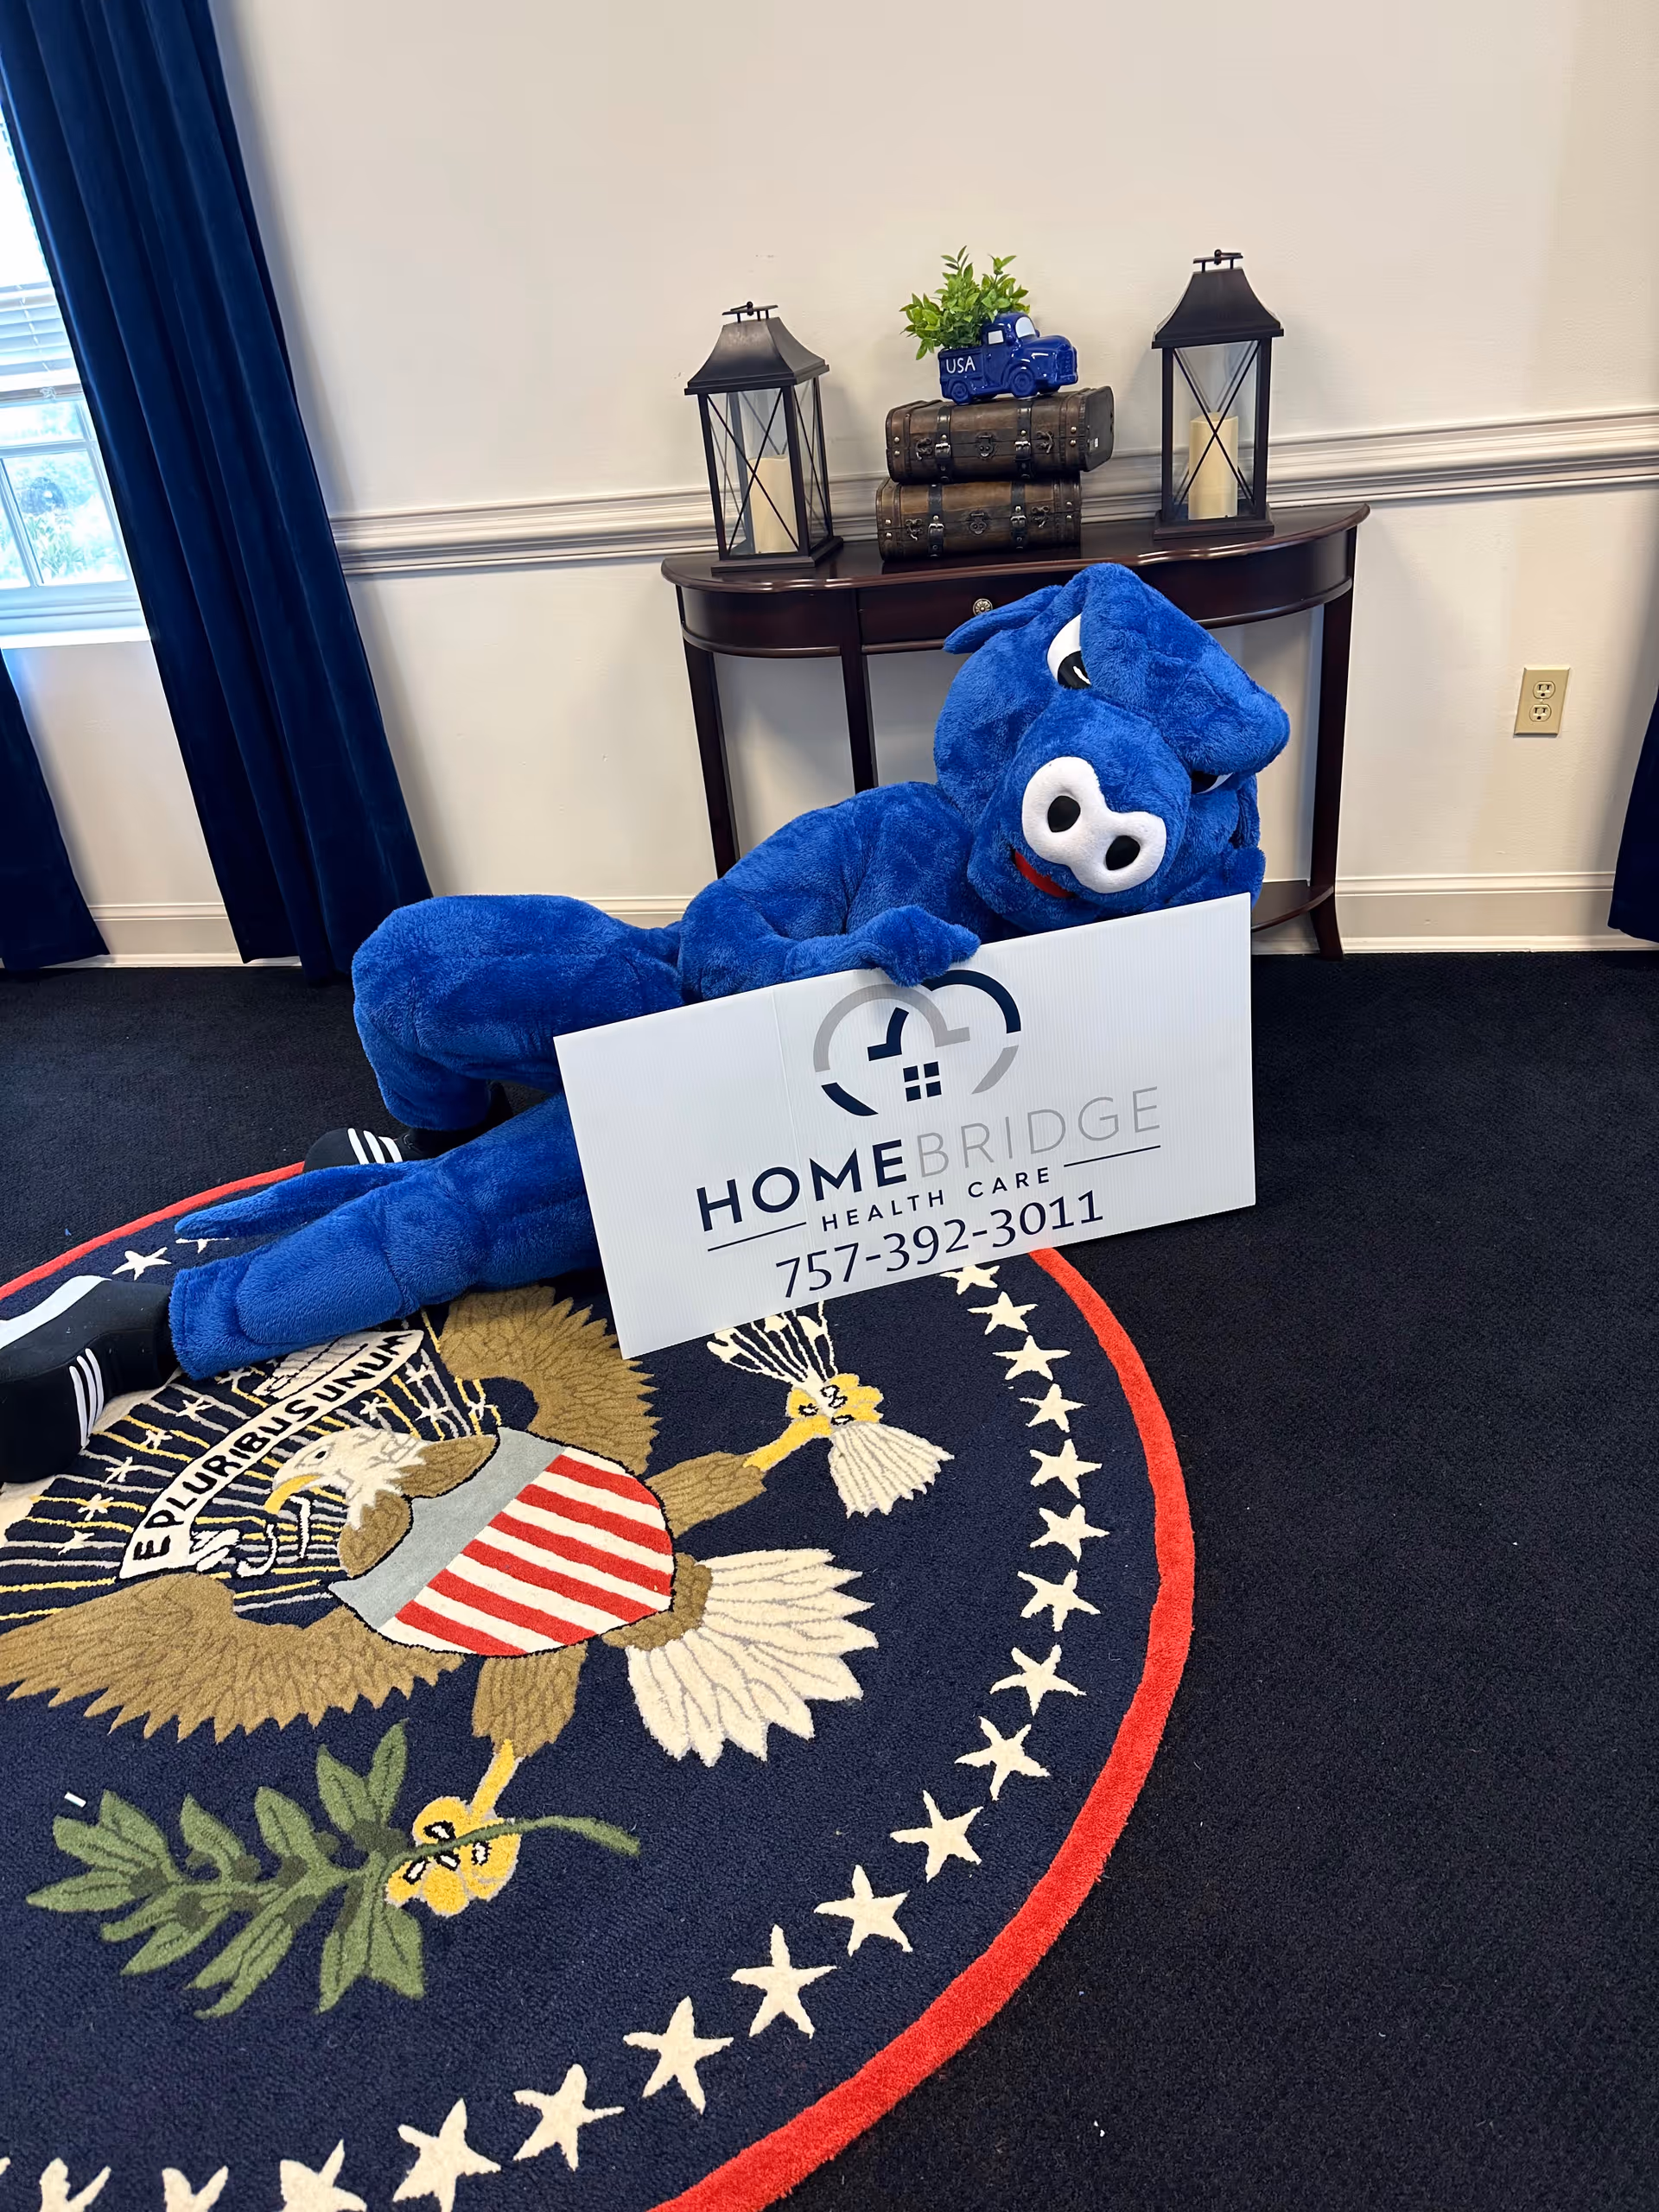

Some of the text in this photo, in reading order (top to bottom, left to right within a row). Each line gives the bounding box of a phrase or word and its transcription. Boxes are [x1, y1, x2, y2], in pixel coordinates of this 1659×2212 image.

[946, 355, 976, 373] USA
[696, 1086, 1160, 1232] HOMEBRIDGE
[822, 1166, 1050, 1232] HEALTH CARE
[775, 1189, 1103, 1298] 757-392-3011
[133, 1535, 171, 1560] E
